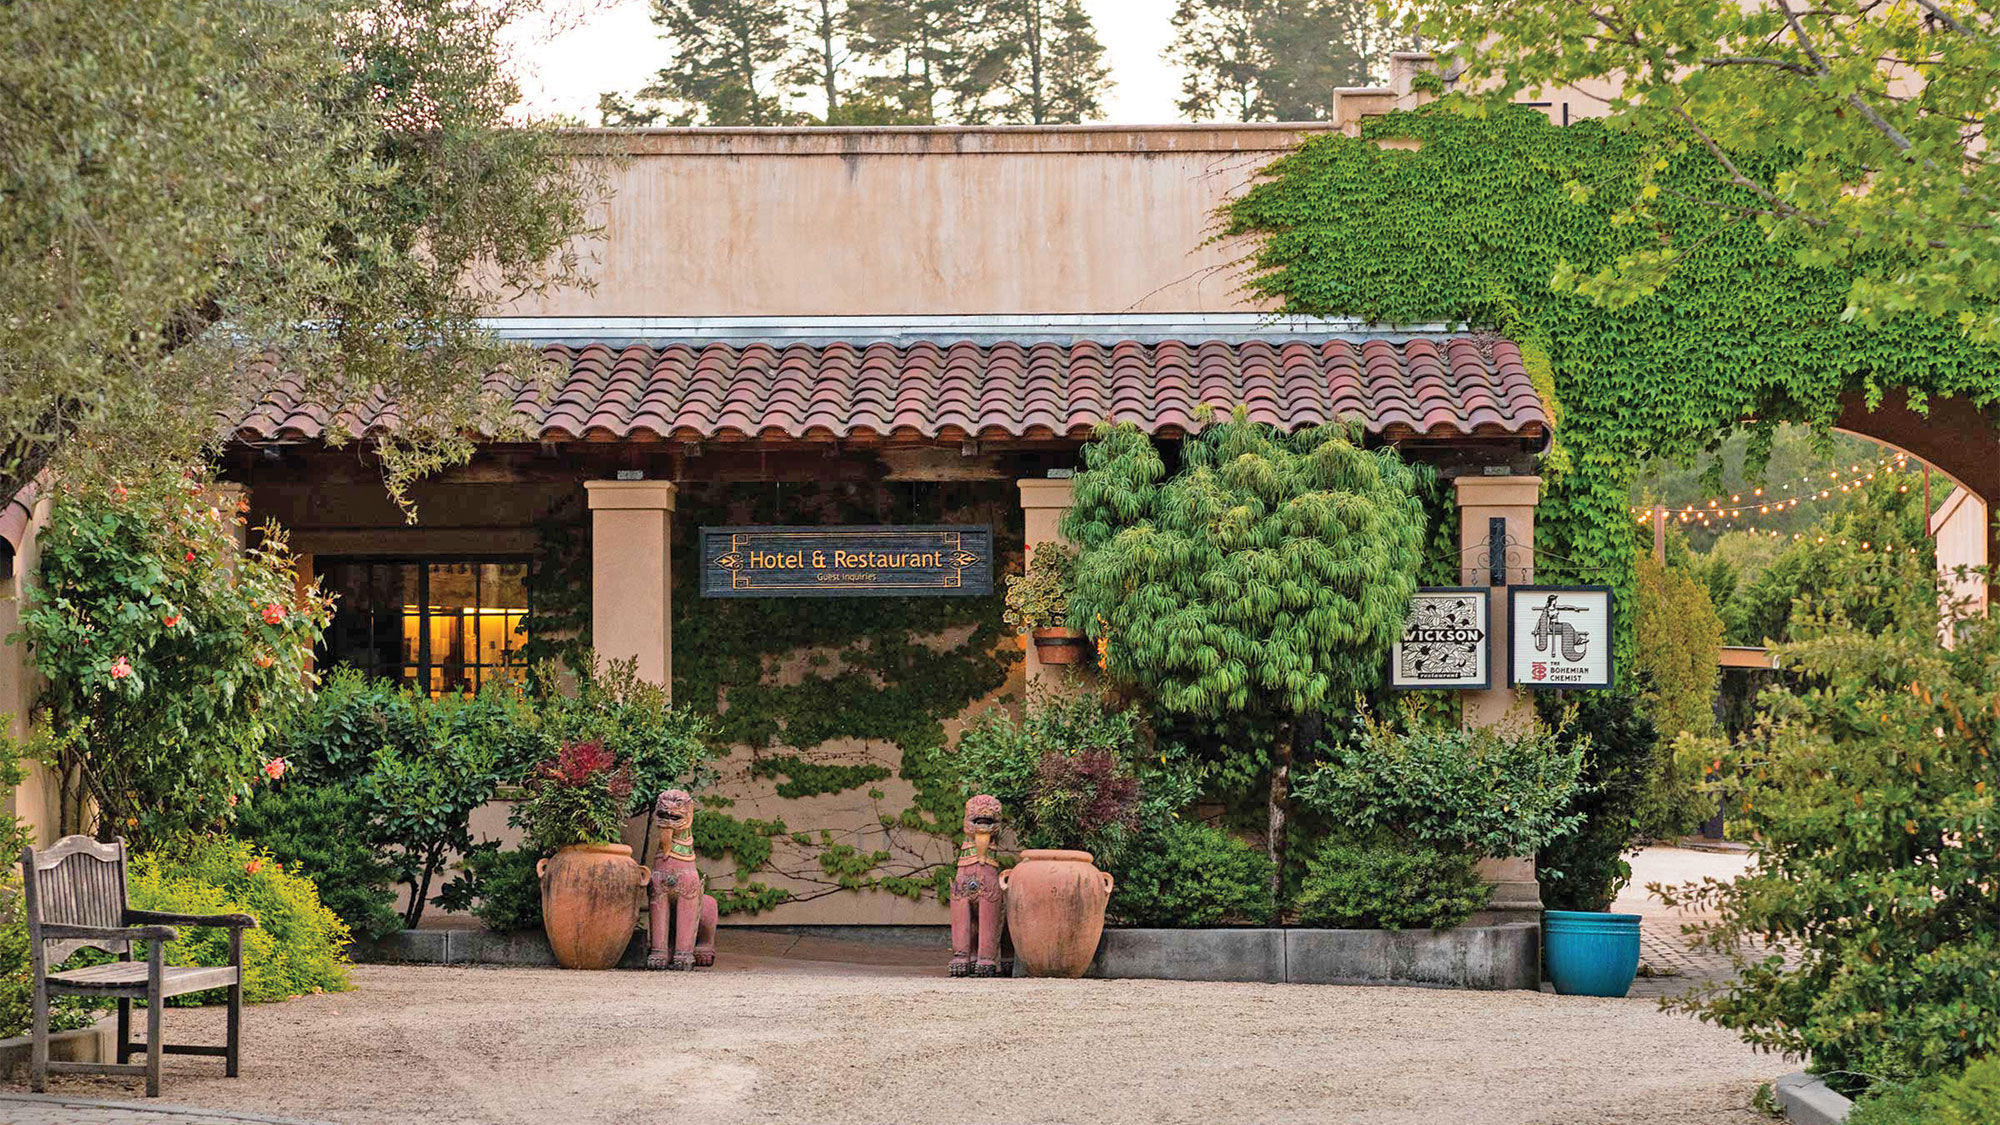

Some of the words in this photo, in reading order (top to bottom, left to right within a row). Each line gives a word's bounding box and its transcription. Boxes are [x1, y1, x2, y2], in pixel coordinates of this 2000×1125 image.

[749, 550, 804, 569] Hotel
[812, 550, 826, 569] &
[834, 550, 944, 569] Restaurant
[1403, 630, 1479, 641] WICKSON
